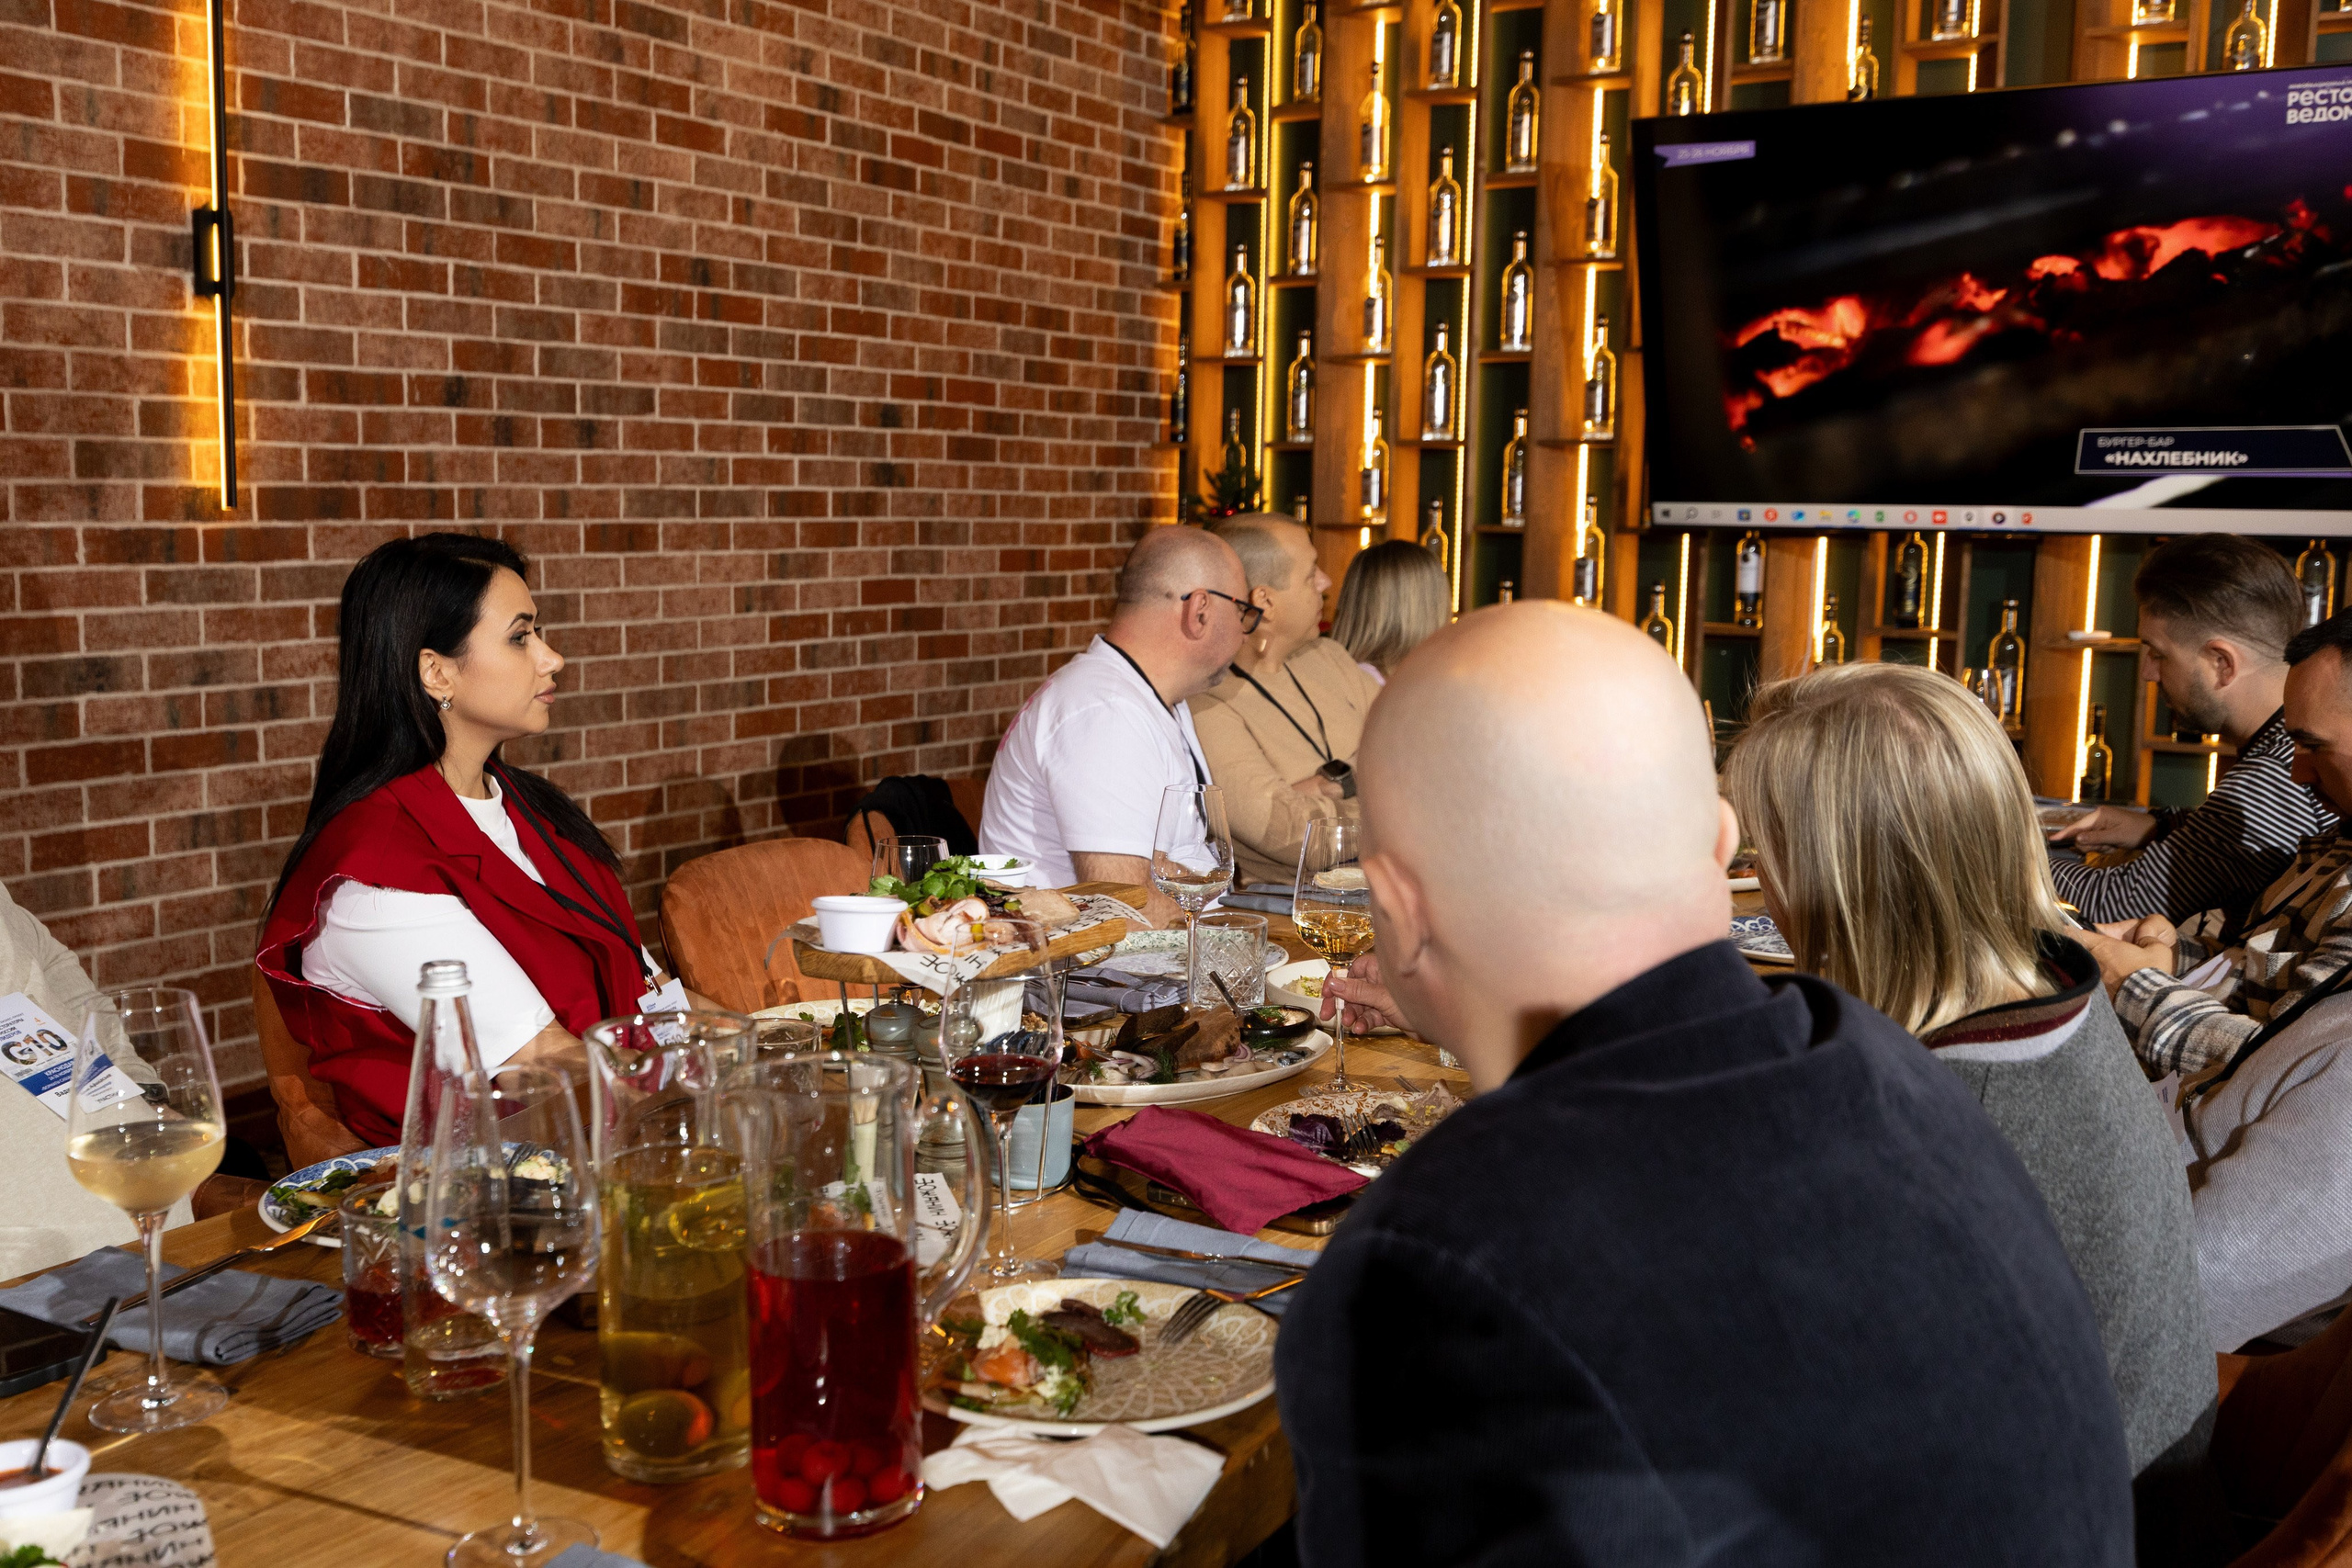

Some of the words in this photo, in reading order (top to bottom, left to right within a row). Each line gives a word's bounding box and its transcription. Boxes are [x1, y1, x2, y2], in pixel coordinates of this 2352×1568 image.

[2097, 436, 2176, 448] БУРГЕР-БАР
[2104, 451, 2249, 467] «НАХЛЕБНИК»
[1, 1029, 68, 1066] G10
